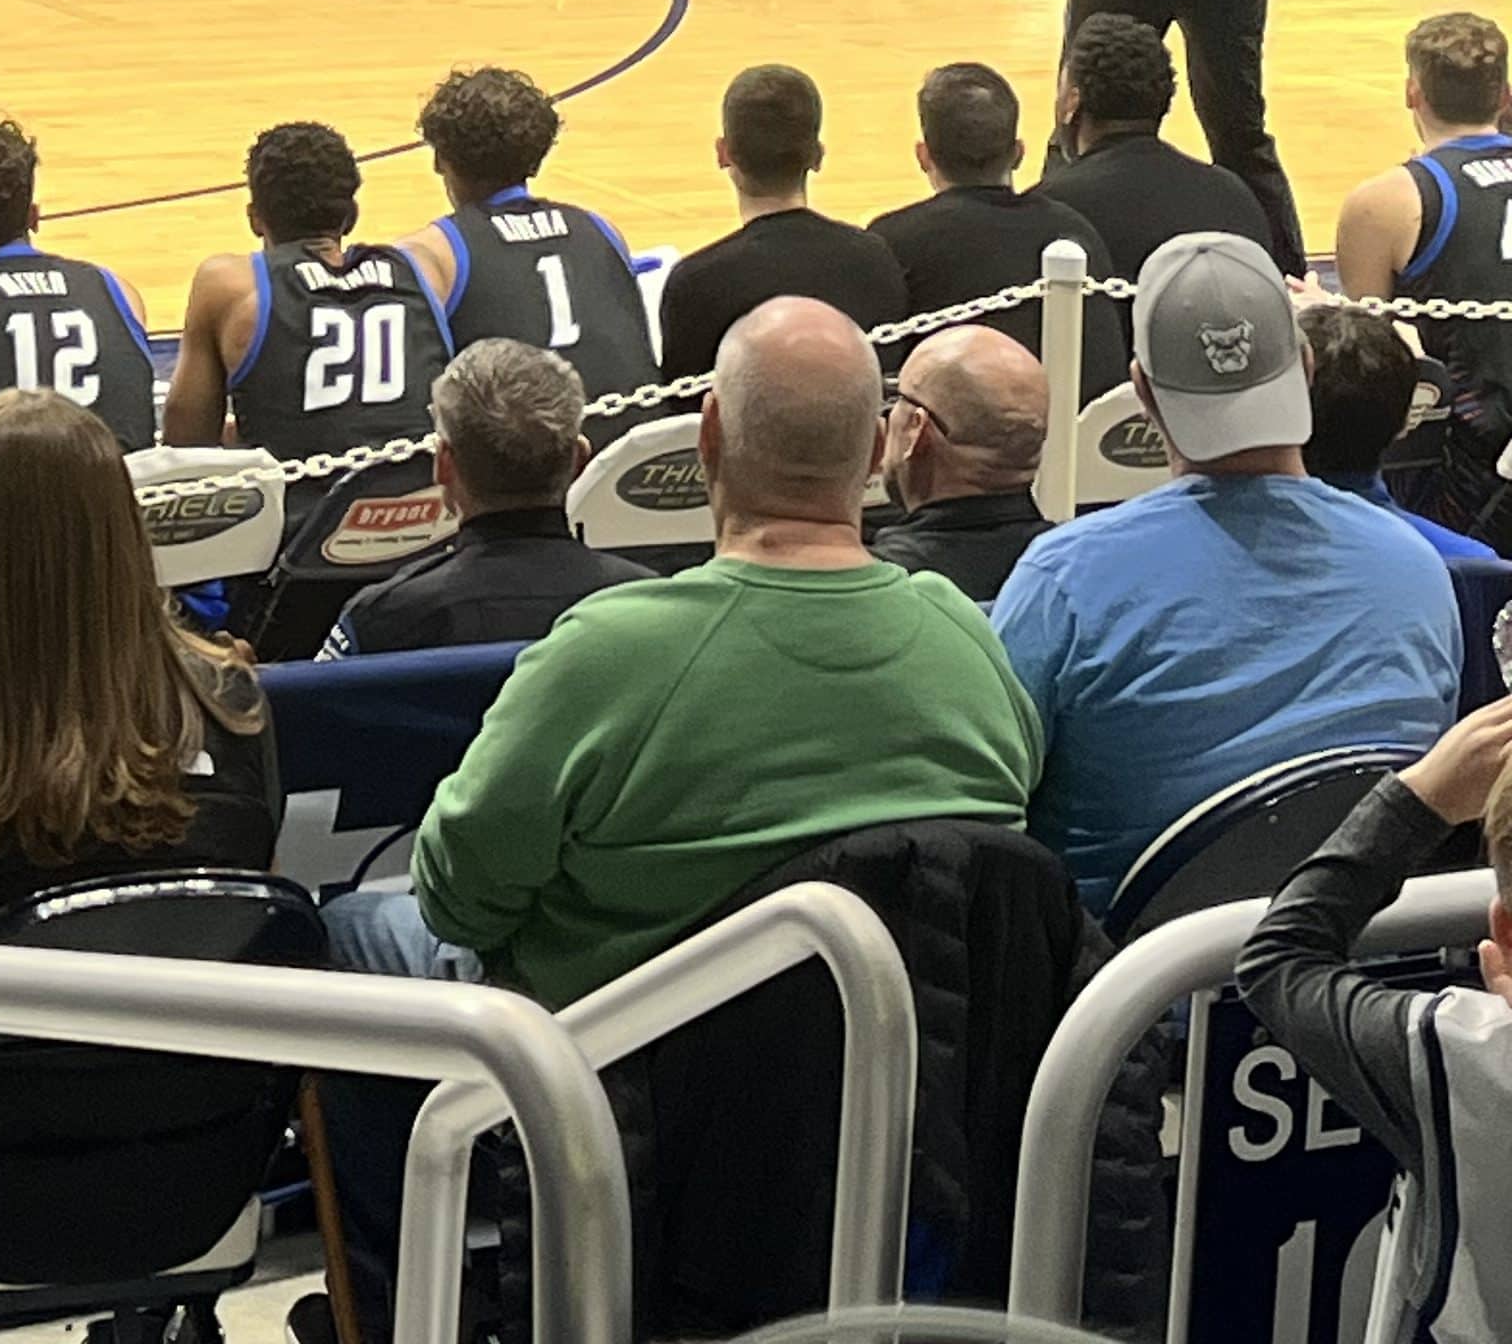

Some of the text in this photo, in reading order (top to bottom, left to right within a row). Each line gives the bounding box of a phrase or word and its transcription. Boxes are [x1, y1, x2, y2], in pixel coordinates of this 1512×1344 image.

[491, 209, 569, 243] RIVERA
[537, 254, 580, 347] 1
[5, 310, 100, 407] 12
[303, 303, 406, 412] 20
[357, 503, 432, 527] bryant
[1228, 1045, 1361, 1162] SE
